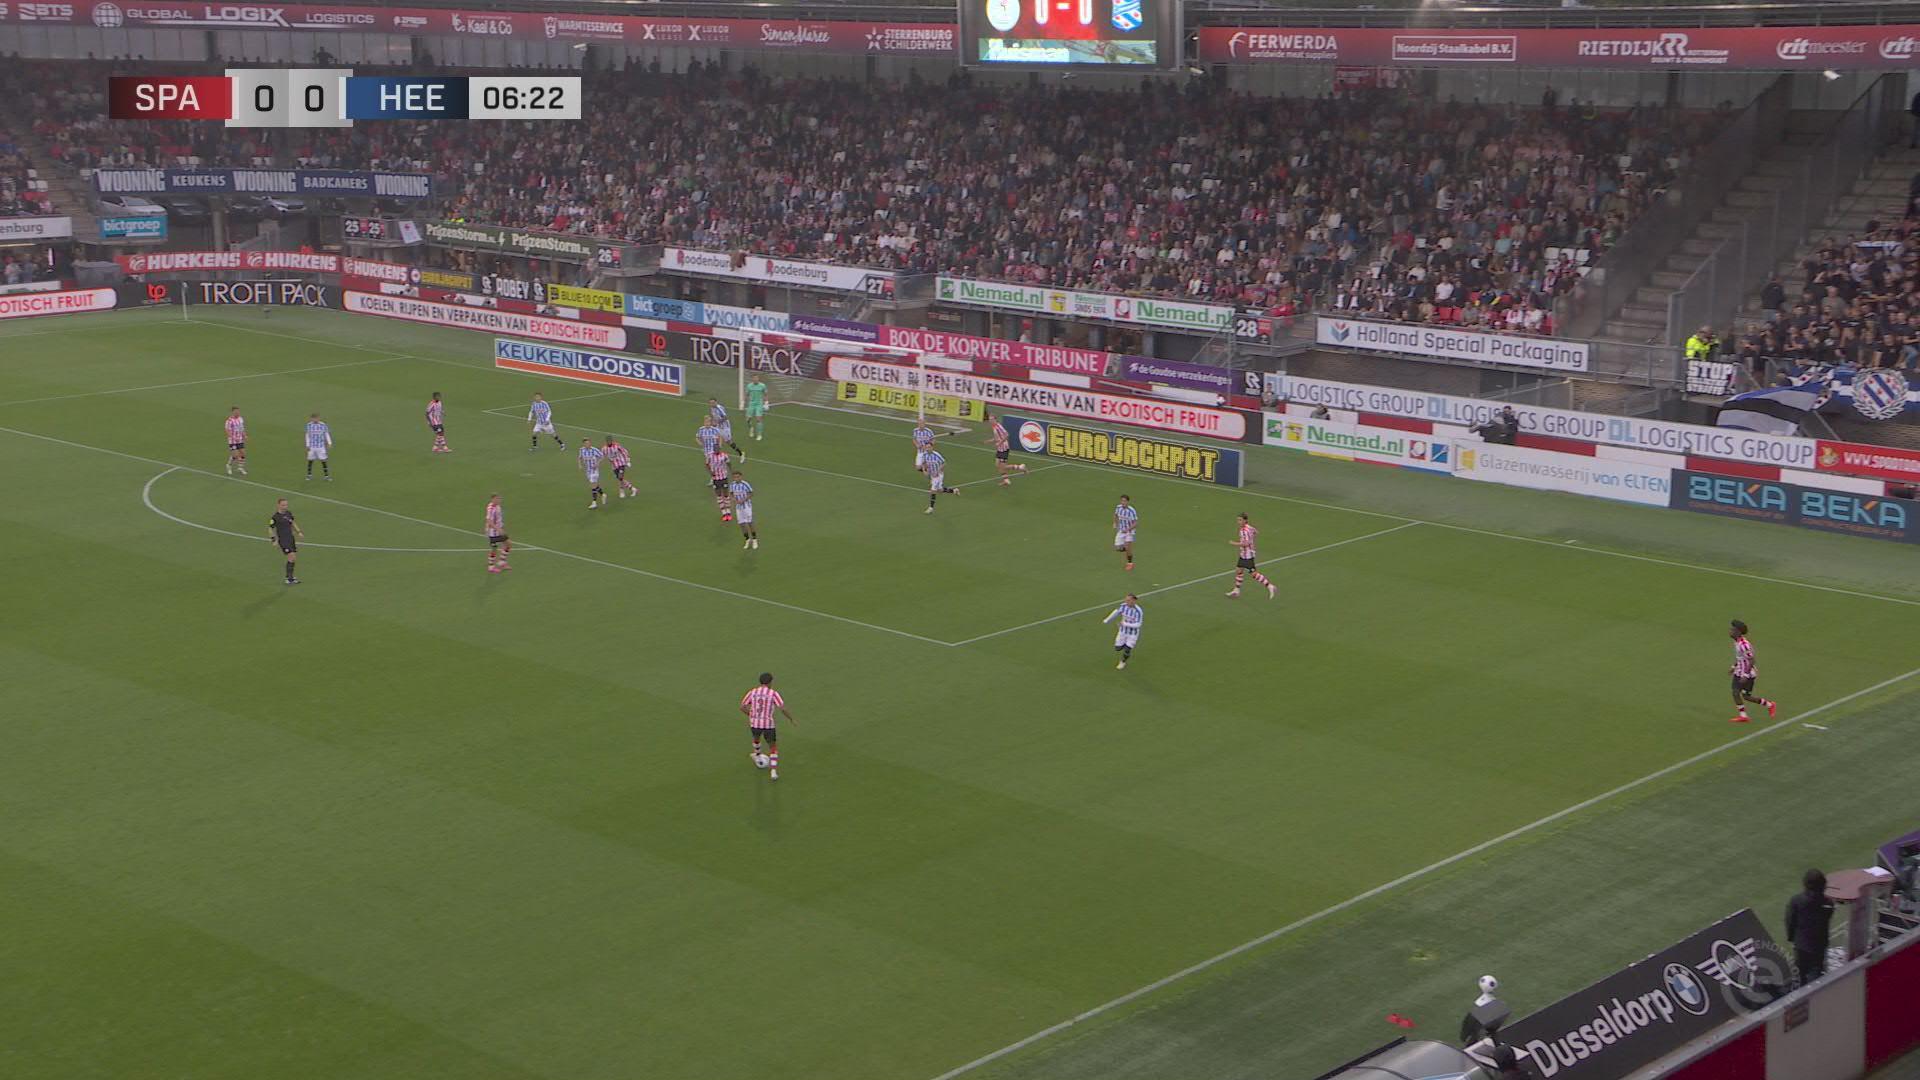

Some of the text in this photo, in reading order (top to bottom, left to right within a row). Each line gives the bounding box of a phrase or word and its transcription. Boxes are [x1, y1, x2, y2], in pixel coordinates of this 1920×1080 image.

[36, 3, 74, 17] BTS
[127, 6, 376, 25] GLOBAL LOGIX LOGISTICS
[489, 20, 498, 34] &
[499, 20, 513, 35] Co
[559, 20, 624, 33] WARMTESERVICE
[884, 27, 953, 41] STERRENBURG
[884, 39, 953, 52] SCHILDERWERK
[1248, 34, 1338, 50] FERWERDA
[1396, 43, 1512, 56] Noordzij Staalkabel B.V.
[1578, 39, 1664, 56] RIETDIJK
[1781, 37, 1868, 55] ritmeester
[97, 170, 429, 197] WOONING KEUKENS WOONING BADKAMERS WOONING
[103, 218, 161, 233] bictgroep
[345, 219, 360, 234] 25
[368, 221, 381, 236] 25
[147, 252, 241, 270] HURKENS
[265, 253, 337, 271] HURKENS
[598, 247, 612, 263] 26
[677, 249, 730, 268] Roodenbur
[353, 259, 407, 283] HURKENS
[766, 258, 828, 281] Roodenburg
[200, 281, 328, 307] TROFI PACK
[495, 277, 530, 300] ROBEY
[867, 278, 884, 295] 27
[959, 281, 1045, 306] Nemad.nl
[58, 294, 94, 309] FRUIT
[633, 295, 684, 318] bictgroep
[399, 300, 430, 318] RIJPEN
[431, 304, 444, 320] EN
[446, 305, 504, 328] VERPAKKEN
[504, 313, 528, 332] VAN
[529, 319, 579, 339] EXOTISCH
[582, 329, 609, 344] FRUIT
[1137, 300, 1233, 325] Nemad.nl
[1236, 318, 1257, 337] 28
[690, 336, 804, 375] TROF PACK
[889, 329, 922, 350] BOK
[923, 333, 945, 352] DE
[948, 335, 1011, 361] KORVER
[1023, 345, 1099, 372] TRIBUNE
[1356, 325, 1583, 368] Holland Special Packaging
[954, 377, 972, 394] EN
[976, 381, 1058, 407] VERPAKKEN
[1062, 393, 1095, 413] VAN
[1100, 399, 1174, 425] EXOTISCH
[1179, 410, 1221, 431] FRUIT
[1290, 381, 1365, 410] LOGISTICS
[1368, 392, 1425, 416] GROUP
[1543, 412, 1607, 440] GROUP
[1639, 425, 1735, 456] LOGISTICS
[1740, 438, 1814, 465] GROUP
[1307, 424, 1405, 454] Nemad.nl
[1048, 425, 1219, 482] EUROJACKPOT
[1479, 452, 1670, 495] Glazenwasserij van ELTEN
[1689, 475, 1787, 512] BEKA
[1800, 491, 1906, 529] BEKA
[1524, 988, 1675, 1079] Dusseldorp
